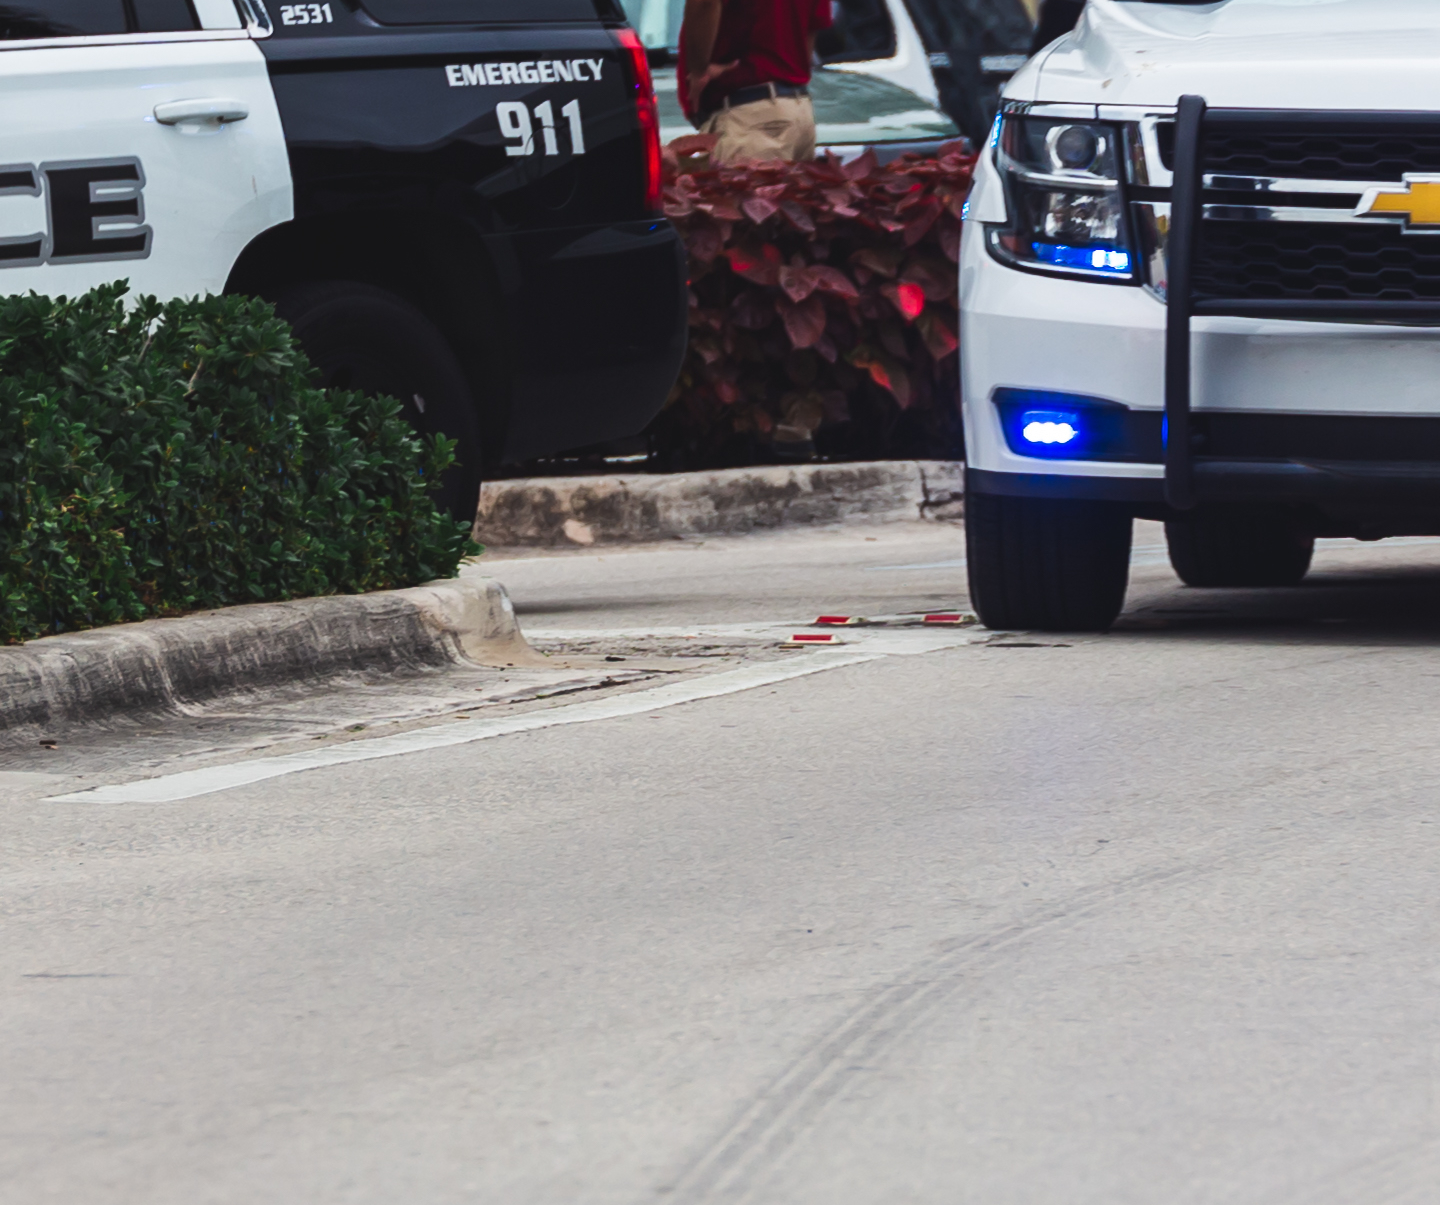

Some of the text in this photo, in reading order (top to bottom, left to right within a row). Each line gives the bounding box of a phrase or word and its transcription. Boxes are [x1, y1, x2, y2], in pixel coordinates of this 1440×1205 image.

[280, 3, 333, 26] 2531
[445, 58, 604, 87] EMERGENCY
[496, 98, 585, 157] 911
